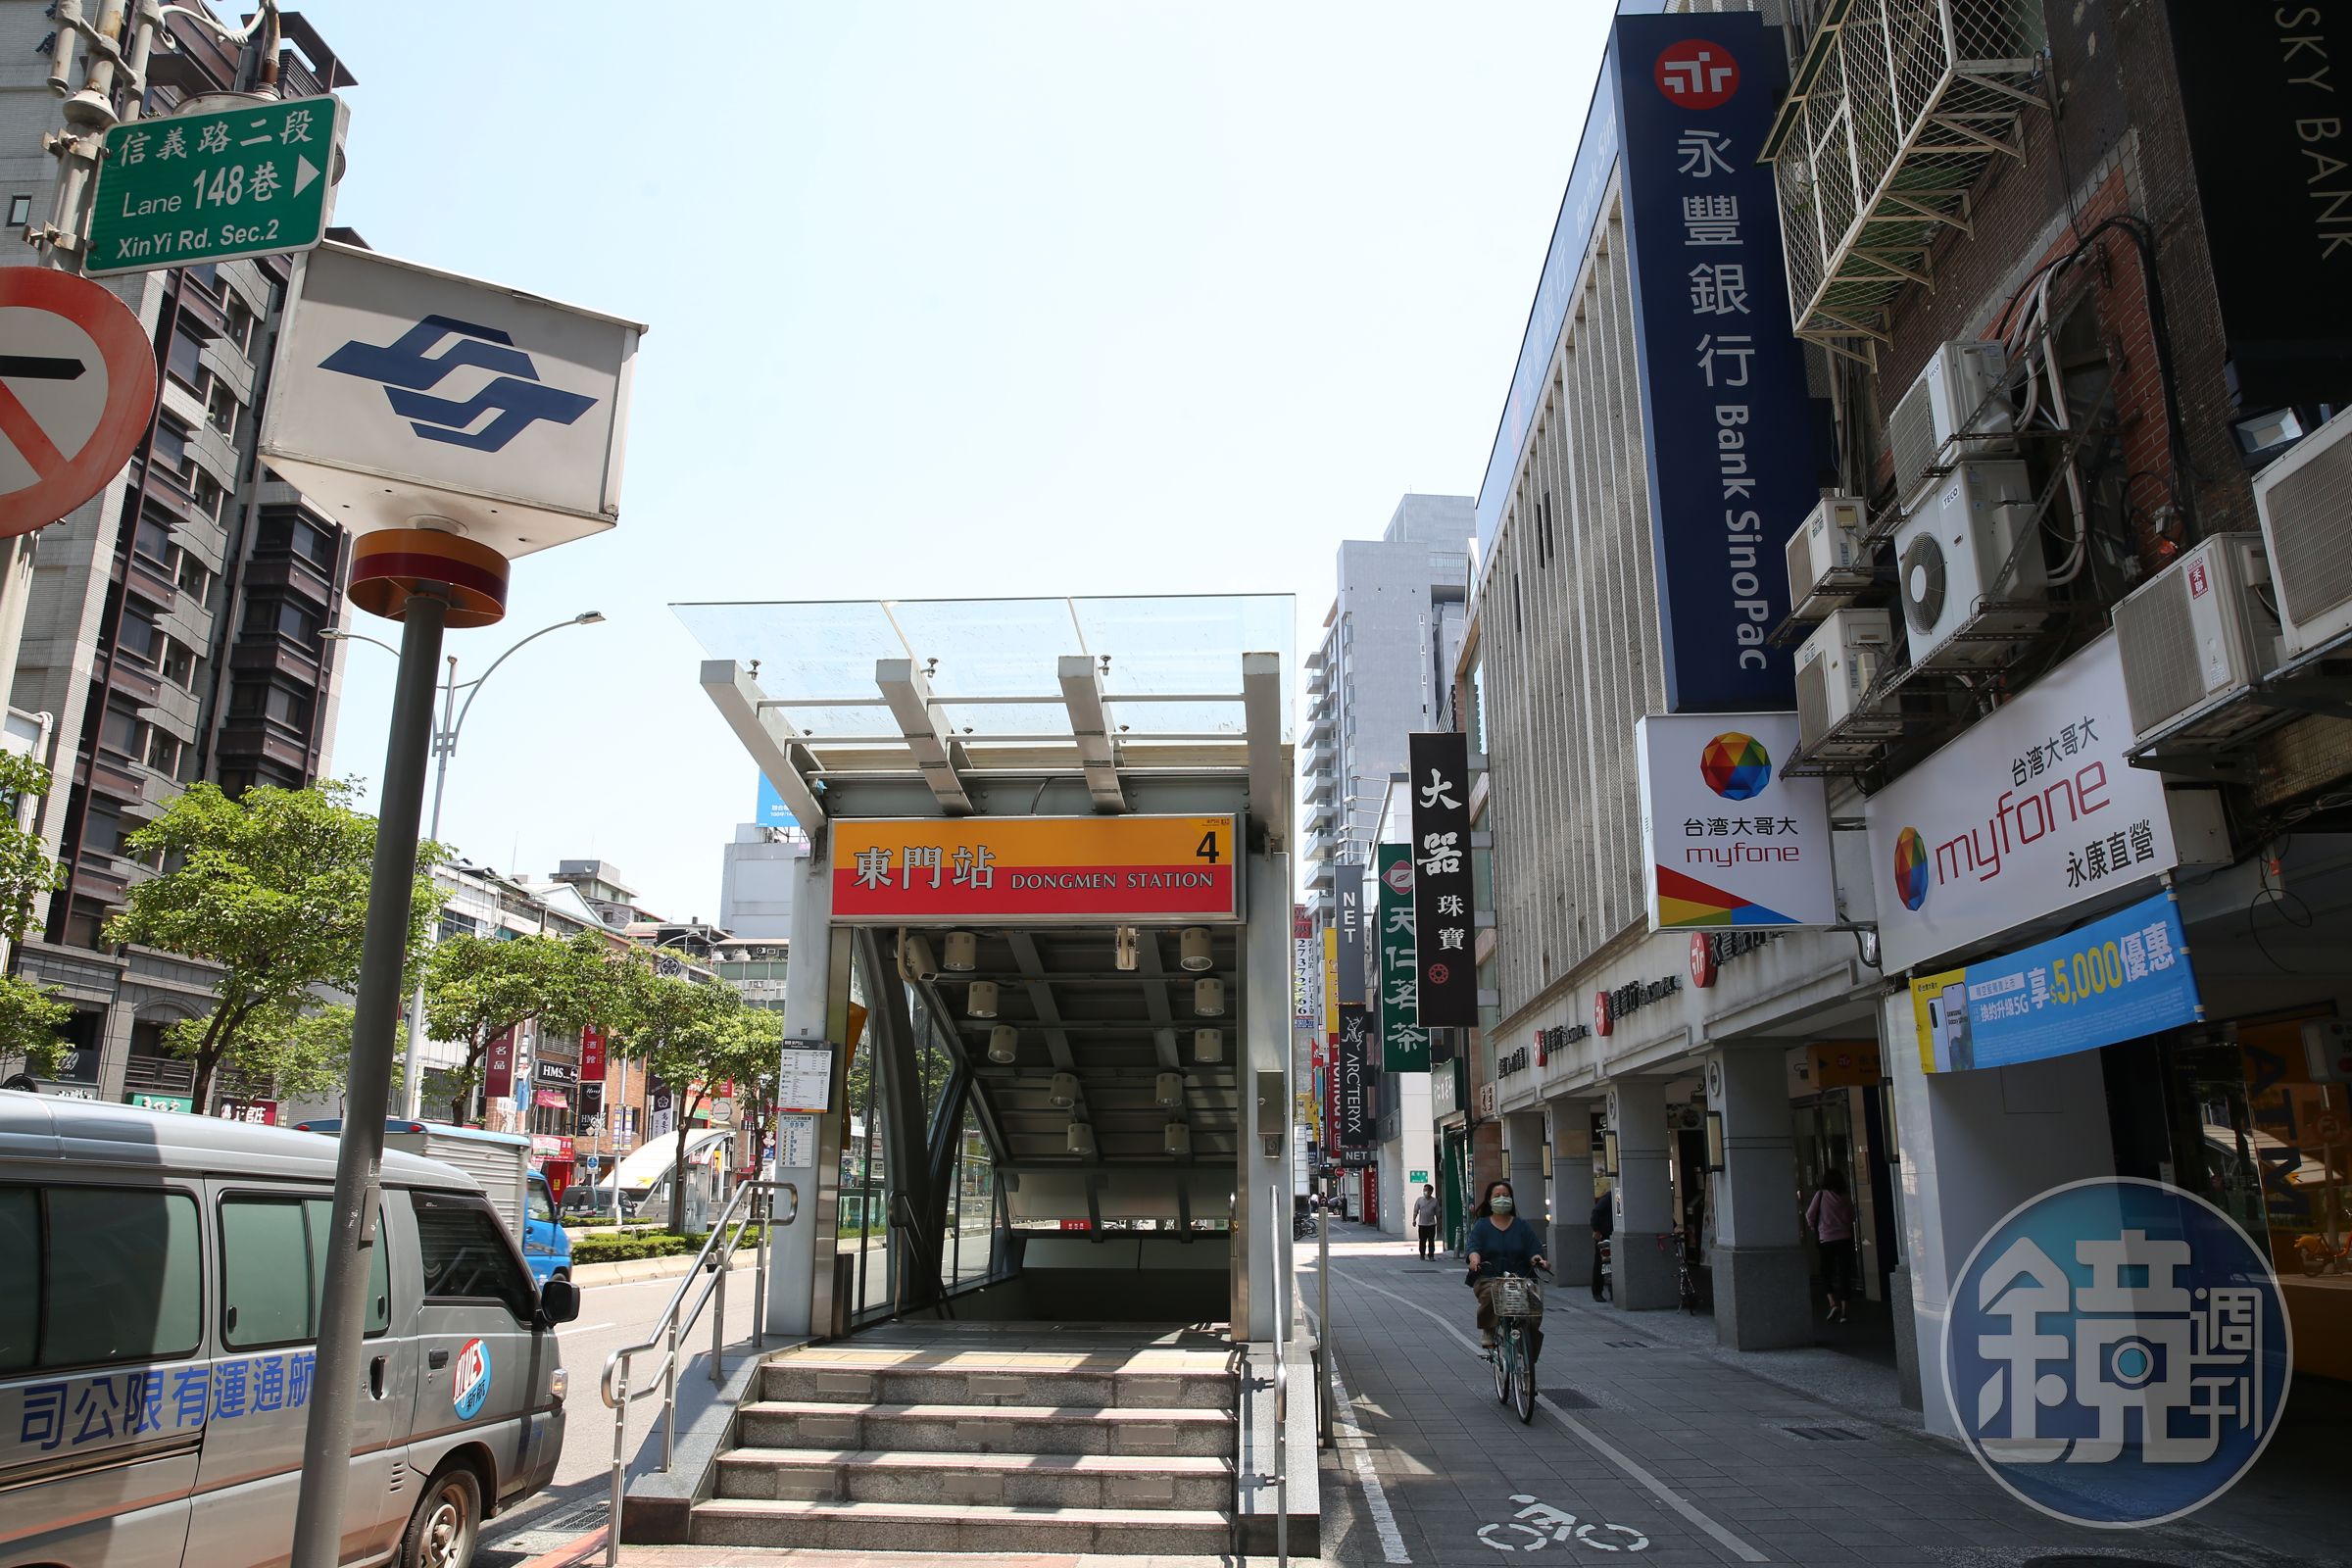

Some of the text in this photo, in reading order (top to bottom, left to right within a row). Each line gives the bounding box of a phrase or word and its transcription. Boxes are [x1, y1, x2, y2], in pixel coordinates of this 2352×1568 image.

[119, 111, 314, 167] 信義路二段
[2275, 7, 2352, 260] SKY BANK
[122, 163, 282, 219] Lane 148巷
[117, 220, 279, 261] XinYi Rd. Sec.2
[1677, 129, 1756, 388] 永豐銀行
[1929, 363, 1940, 379] TECO
[1943, 488, 1959, 508] TECO
[1715, 405, 1768, 670] Bank SinoPac
[2011, 715, 2099, 787] 台湾大哥大
[1196, 831, 1220, 863] 4
[1683, 816, 1798, 836] 台湾大哥大
[1936, 760, 2110, 886] myfone
[853, 845, 997, 891] 東門站
[1011, 871, 1214, 890] DONGMEN STATION
[1686, 842, 1799, 867] myfone
[2066, 819, 2155, 888] 永康直營
[1343, 892, 1356, 944] NET
[1385, 907, 1428, 1053] 天仁茗茶
[1347, 1053, 1361, 1133] ARC'TERYX
[1346, 1152, 1368, 1160] NET
